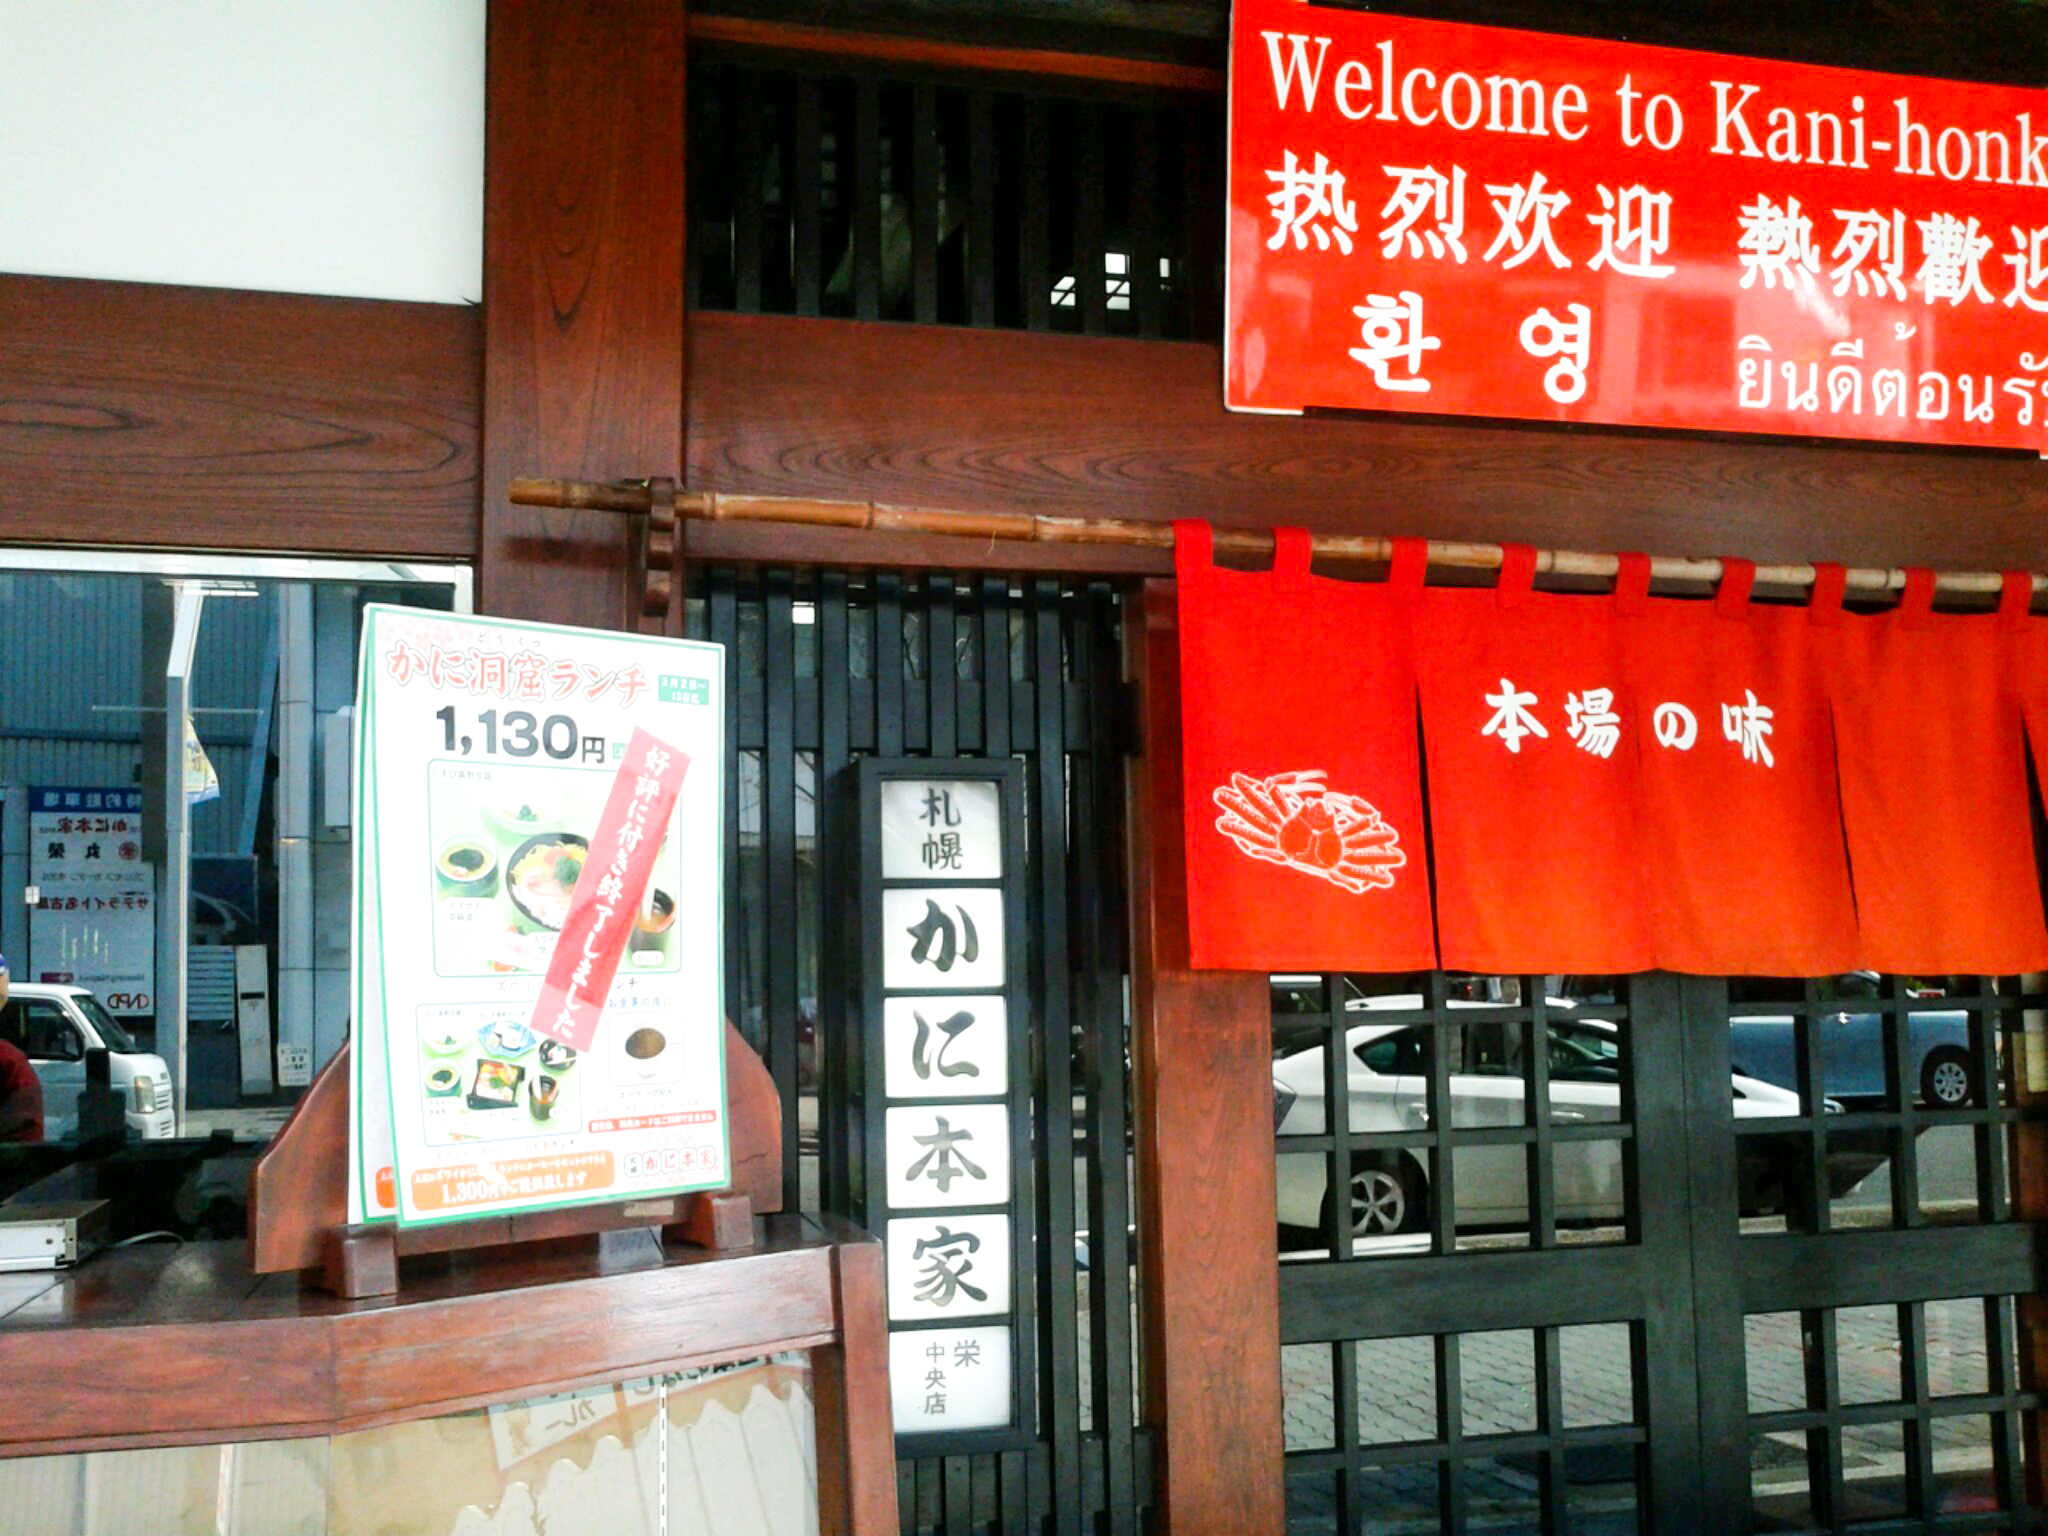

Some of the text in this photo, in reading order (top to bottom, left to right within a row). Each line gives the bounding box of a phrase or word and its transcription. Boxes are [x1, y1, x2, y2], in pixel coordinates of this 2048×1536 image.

[1261, 31, 2048, 188] Welcome to Kani-honk
[1265, 150, 1676, 278] 热烈欢迎
[1737, 323, 2048, 428] ยินดีต้อนรั
[388, 640, 650, 707] かに洞窟ランチ
[1481, 678, 1775, 768] 本場の味
[436, 705, 606, 764] 1,130円
[552, 745, 671, 1039] 好評に付き終了しました
[906, 787, 988, 1307] 札幌 かに本家
[924, 1341, 948, 1416] 中央店
